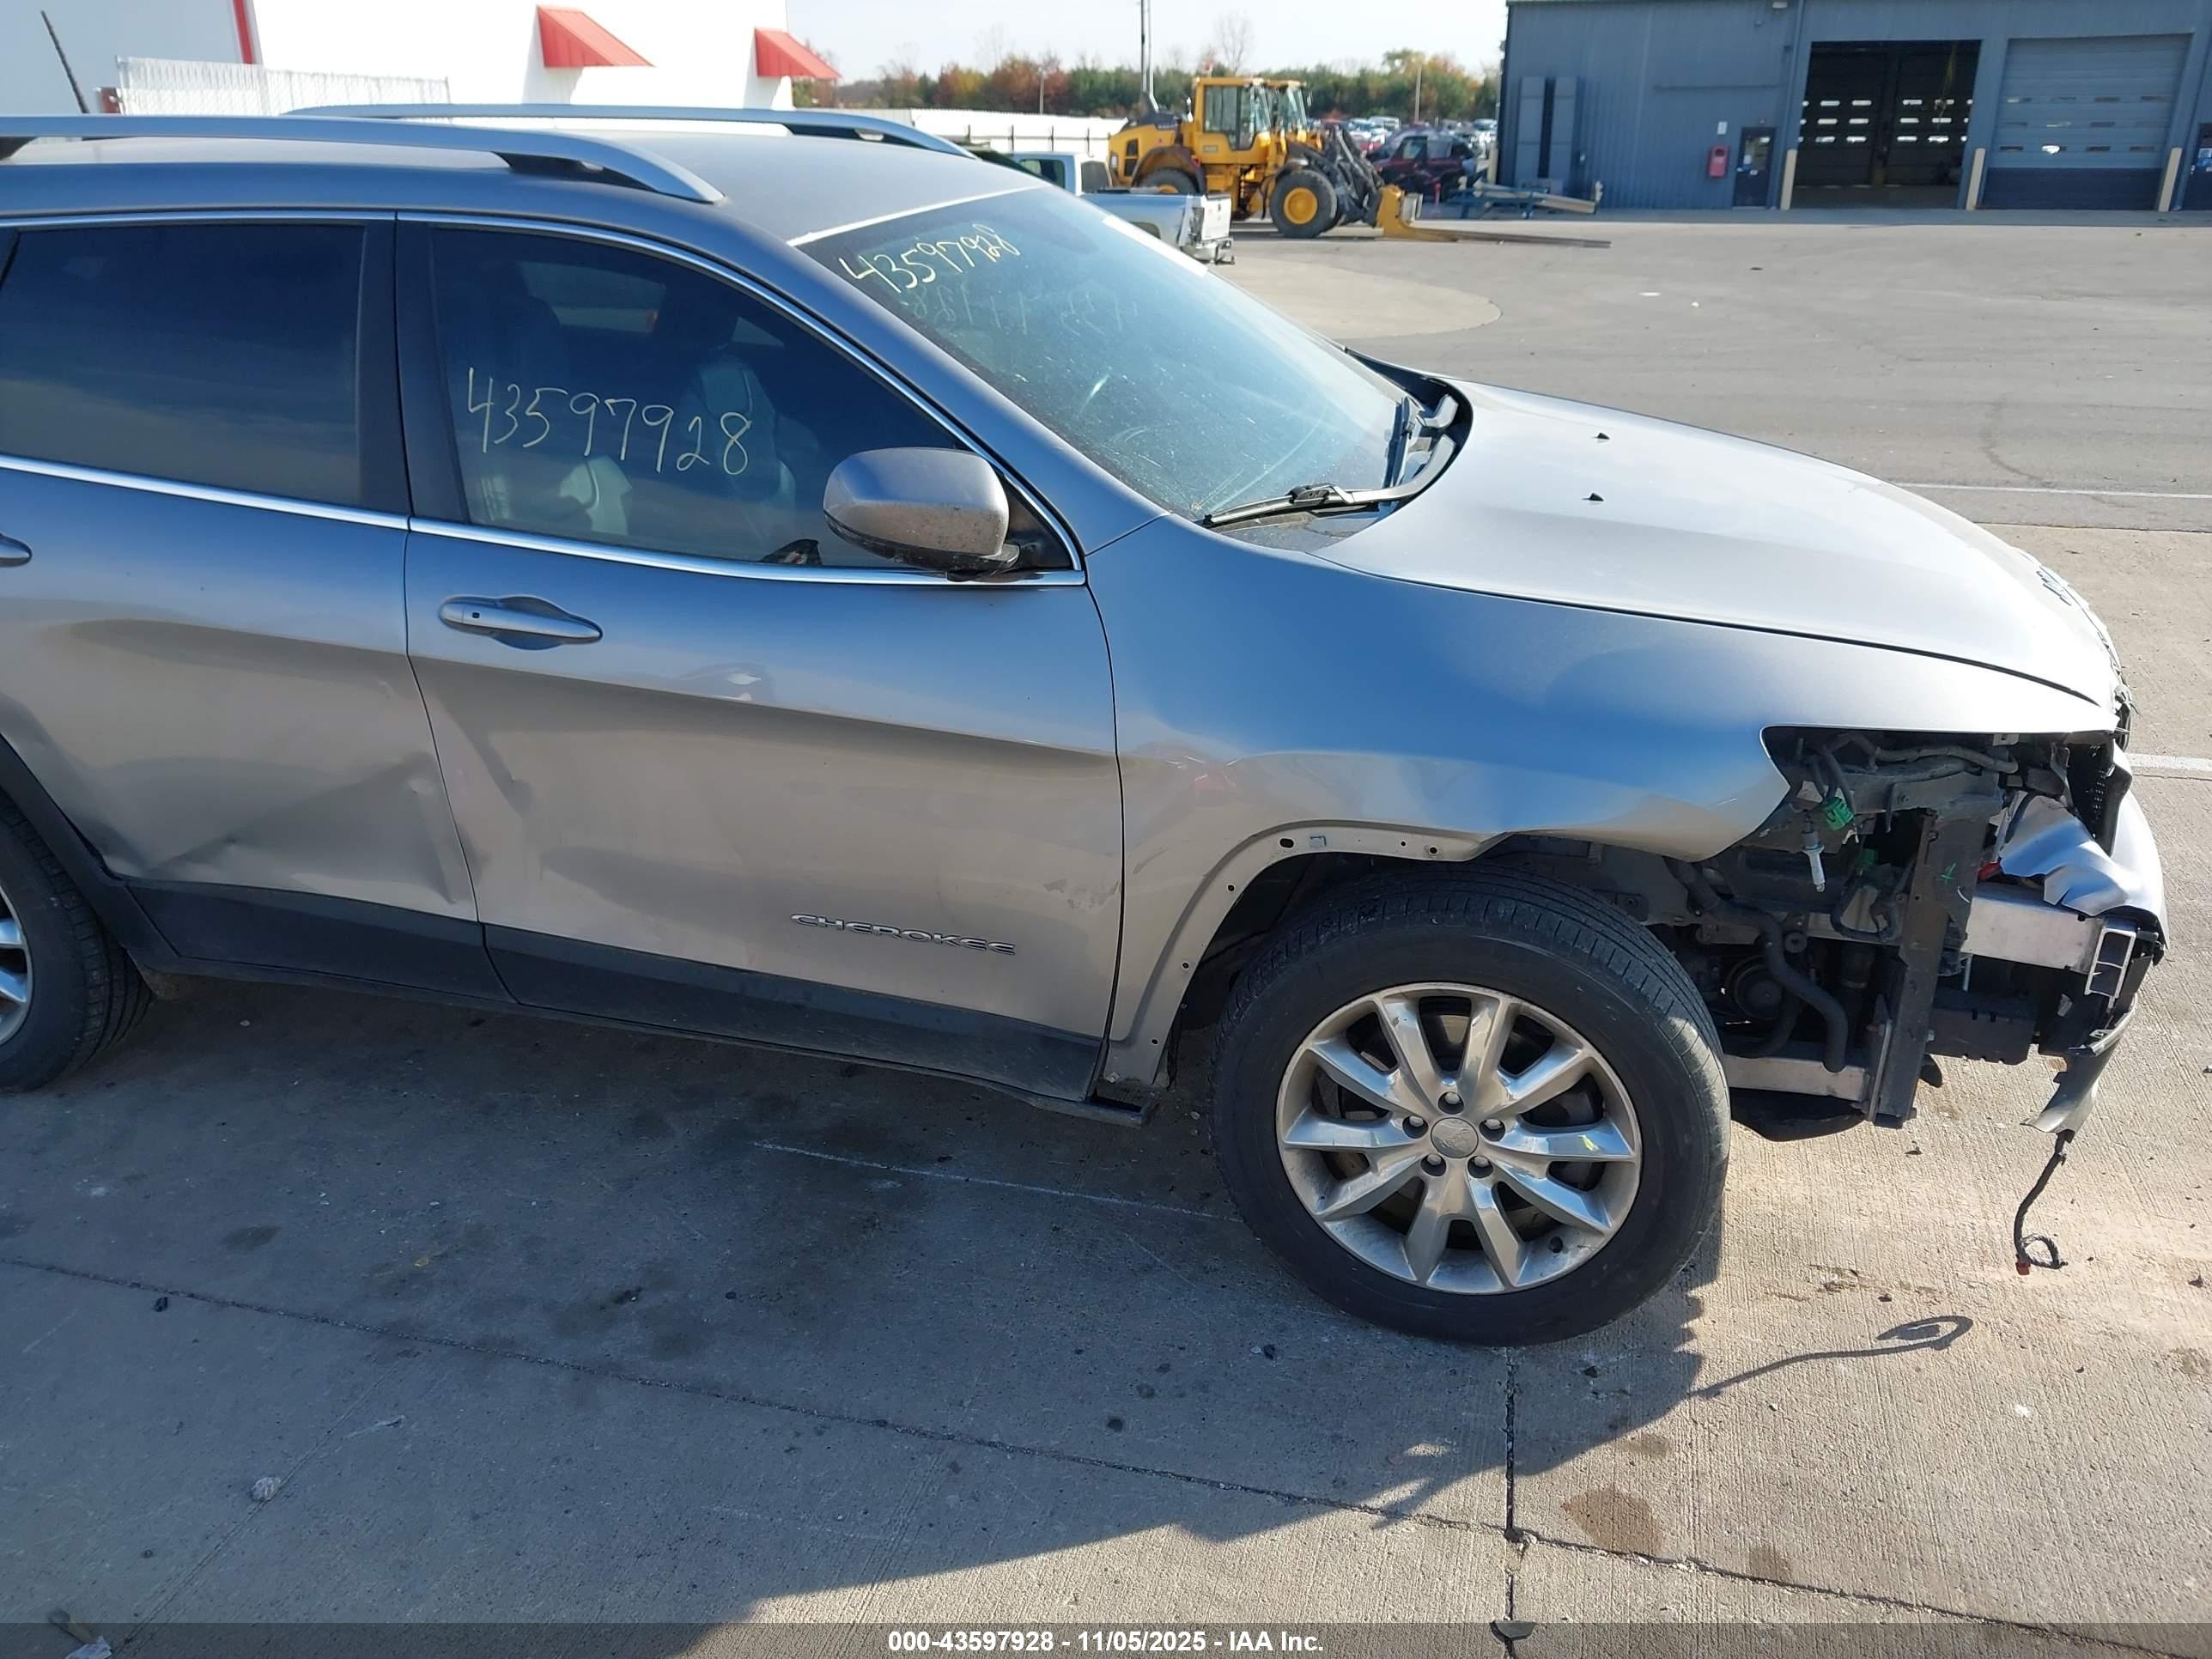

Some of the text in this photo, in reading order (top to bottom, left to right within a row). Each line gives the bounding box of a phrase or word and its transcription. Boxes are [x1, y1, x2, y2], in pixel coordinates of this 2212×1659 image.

[839, 223, 1021, 293] 43597928
[467, 367, 753, 475] 43597928
[790, 913, 1016, 956] CHEROKEE
